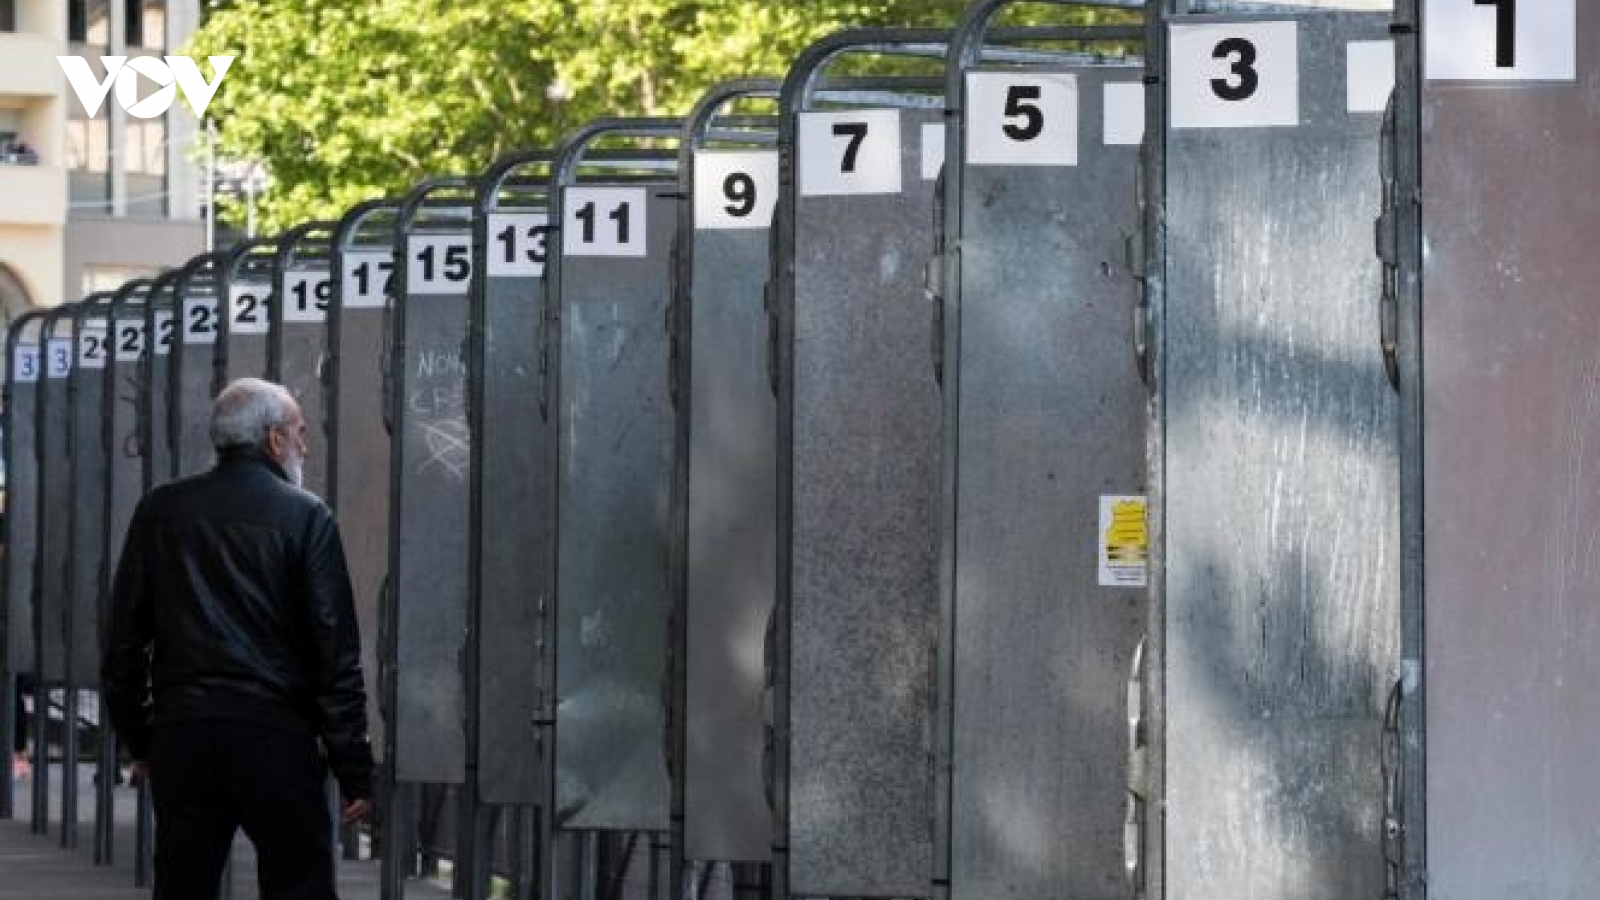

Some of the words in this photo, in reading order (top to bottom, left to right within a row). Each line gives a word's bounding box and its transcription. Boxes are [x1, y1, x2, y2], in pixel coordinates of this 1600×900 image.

[1474, 0, 1516, 68] 1
[1210, 37, 1259, 102] 3
[1002, 85, 1044, 142] 5
[832, 122, 868, 173] 7
[722, 172, 757, 217] 9
[497, 225, 548, 263] 13
[575, 201, 630, 244] 11
[352, 261, 393, 296] 17
[416, 244, 471, 282] 15
[291, 279, 331, 311] 19
[121, 326, 145, 352] 2
